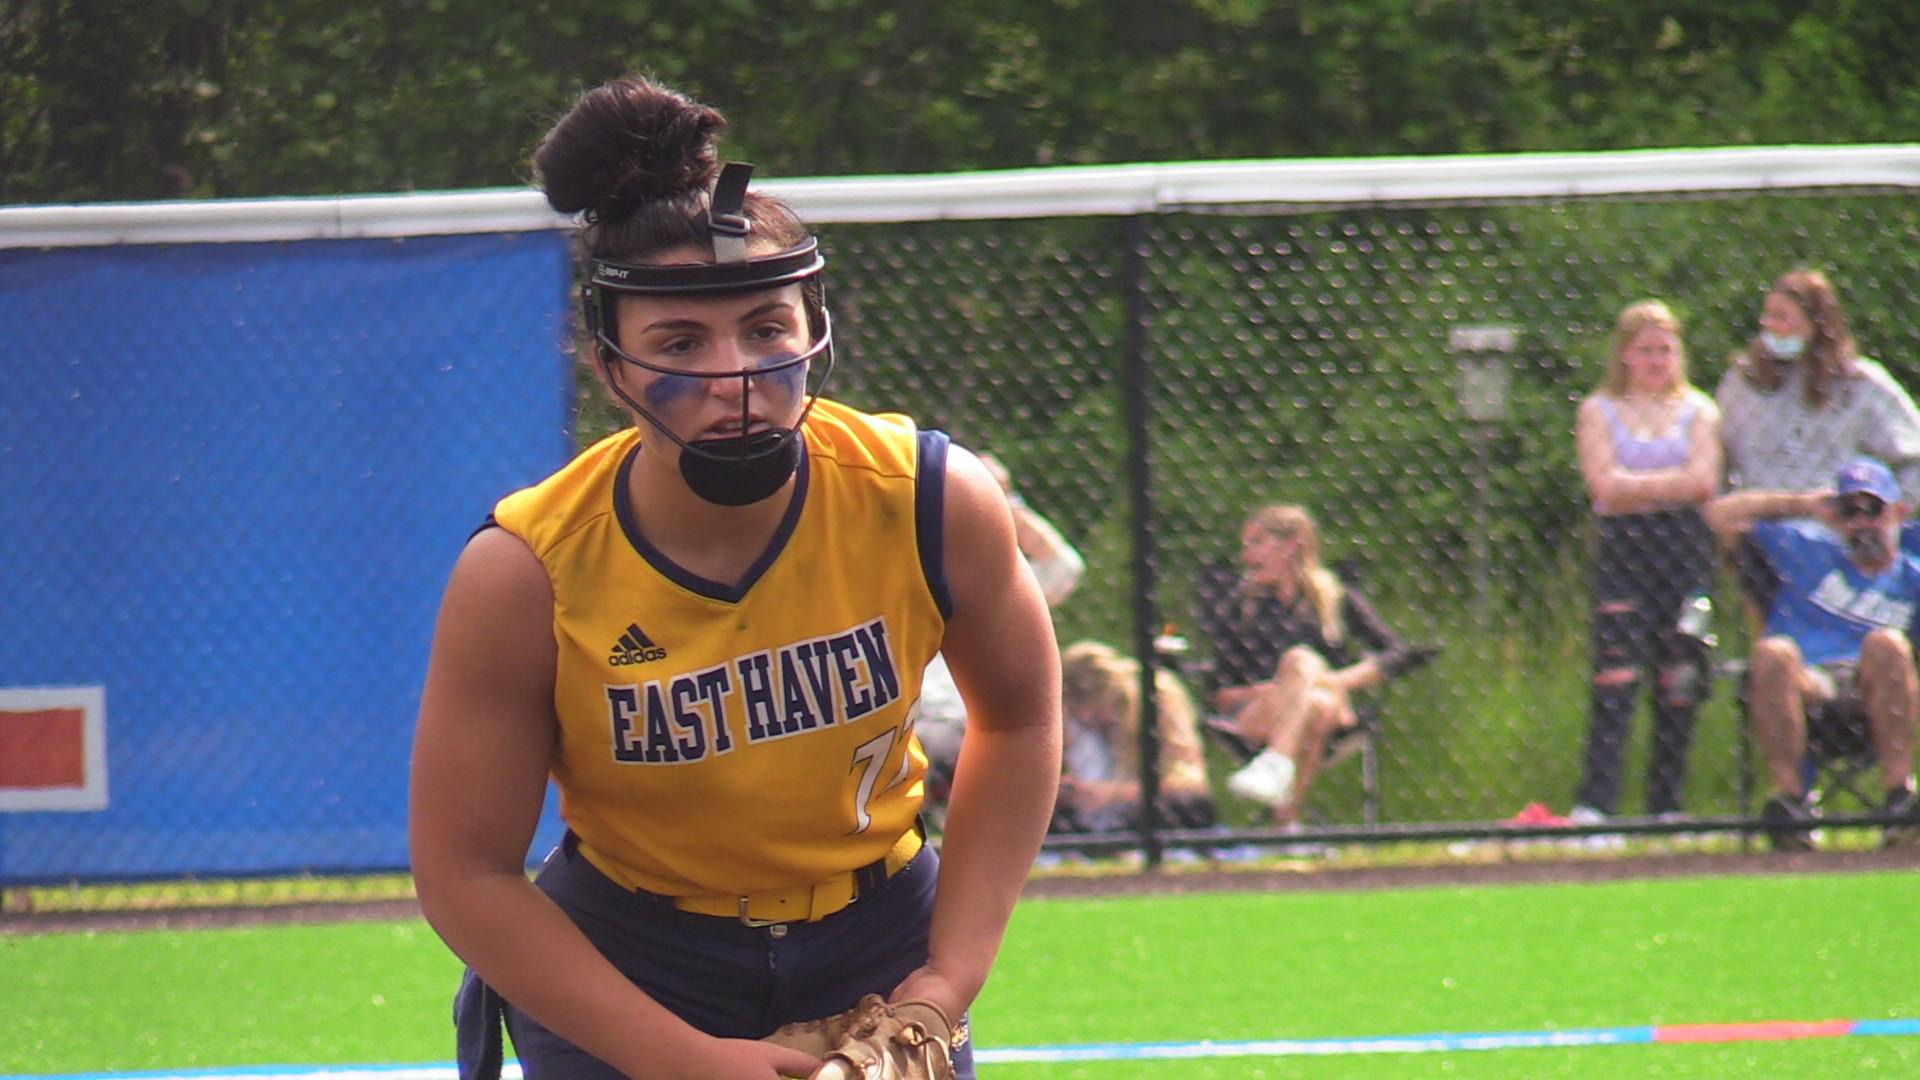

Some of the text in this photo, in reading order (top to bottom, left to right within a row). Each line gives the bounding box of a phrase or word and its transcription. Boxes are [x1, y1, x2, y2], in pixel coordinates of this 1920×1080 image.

[605, 616, 901, 765] EAST HAVEN
[608, 647, 667, 666] adidas
